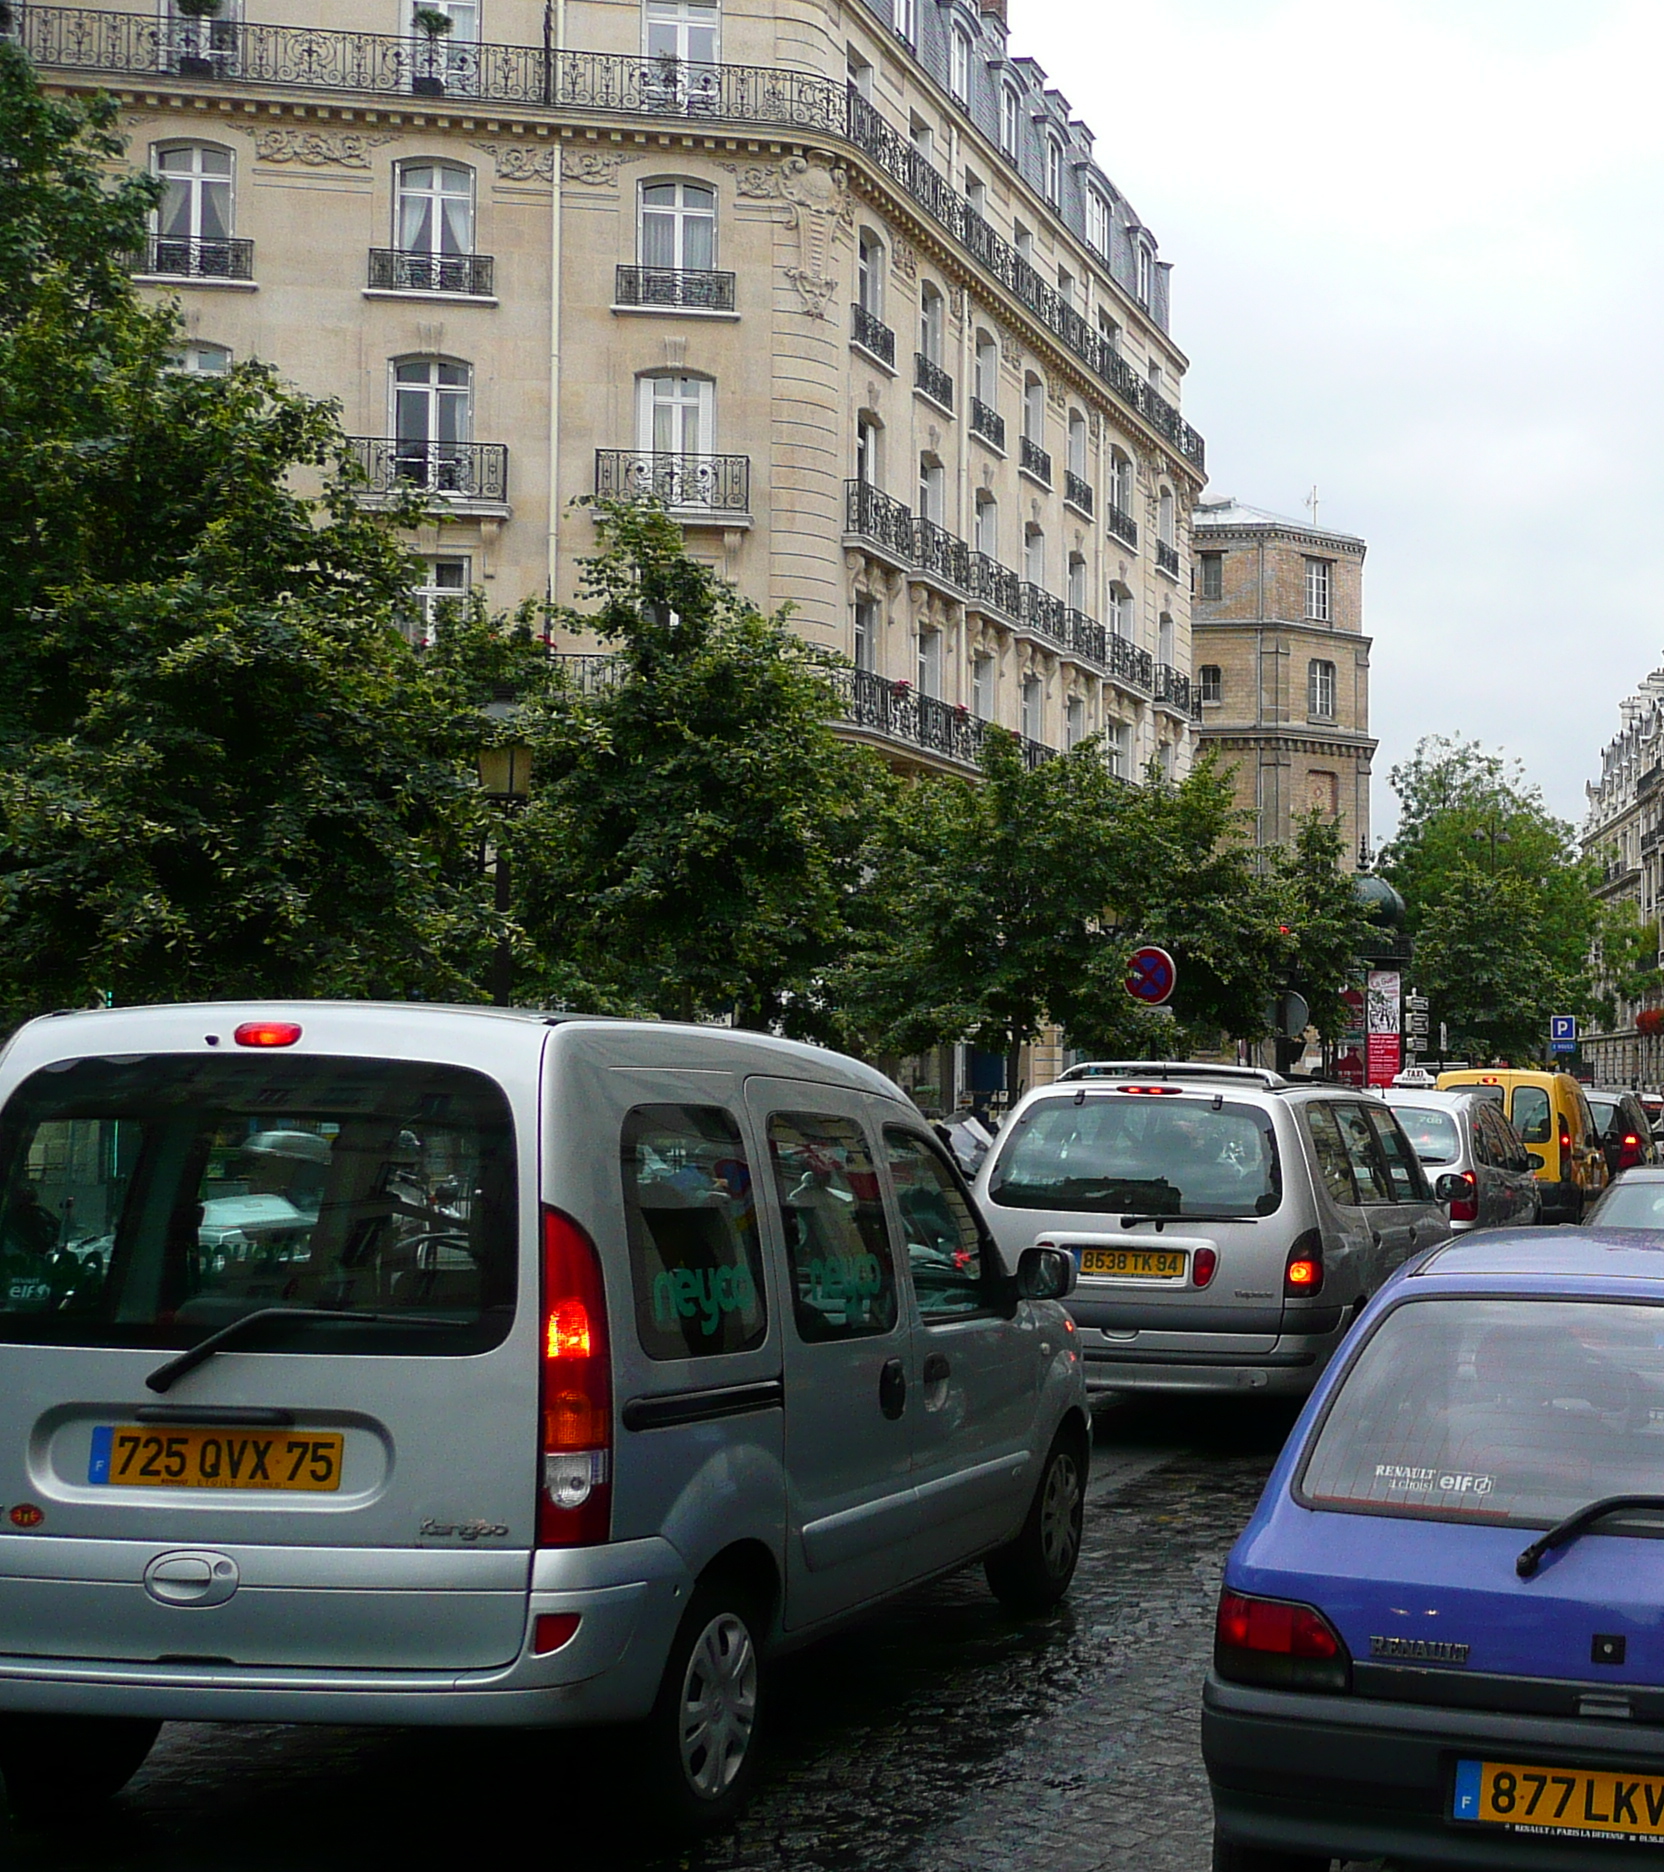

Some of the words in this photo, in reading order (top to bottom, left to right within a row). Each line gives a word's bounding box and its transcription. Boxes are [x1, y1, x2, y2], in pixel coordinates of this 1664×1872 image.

[1557, 1020, 1568, 1036] P
[1406, 1069, 1424, 1077] TAXI
[1132, 1253, 1152, 1271] TK
[1156, 1254, 1178, 1273] 94
[653, 1263, 756, 1335] neyco
[95, 1460, 104, 1472] F
[118, 1436, 189, 1478] 725
[198, 1438, 273, 1480] QVX
[286, 1441, 336, 1482] 75
[1375, 1464, 1437, 1480] RENAULT
[1440, 1475, 1473, 1492] elf
[1398, 1479, 1434, 1491] choisi
[1370, 1635, 1471, 1664] RENAULT
[1461, 1796, 1472, 1809] F
[1490, 1771, 1576, 1818] 877
[1515, 1824, 1549, 1835] RENAULT
[1556, 1826, 1580, 1837] PARIS
[1580, 1829, 1591, 1838] LA
